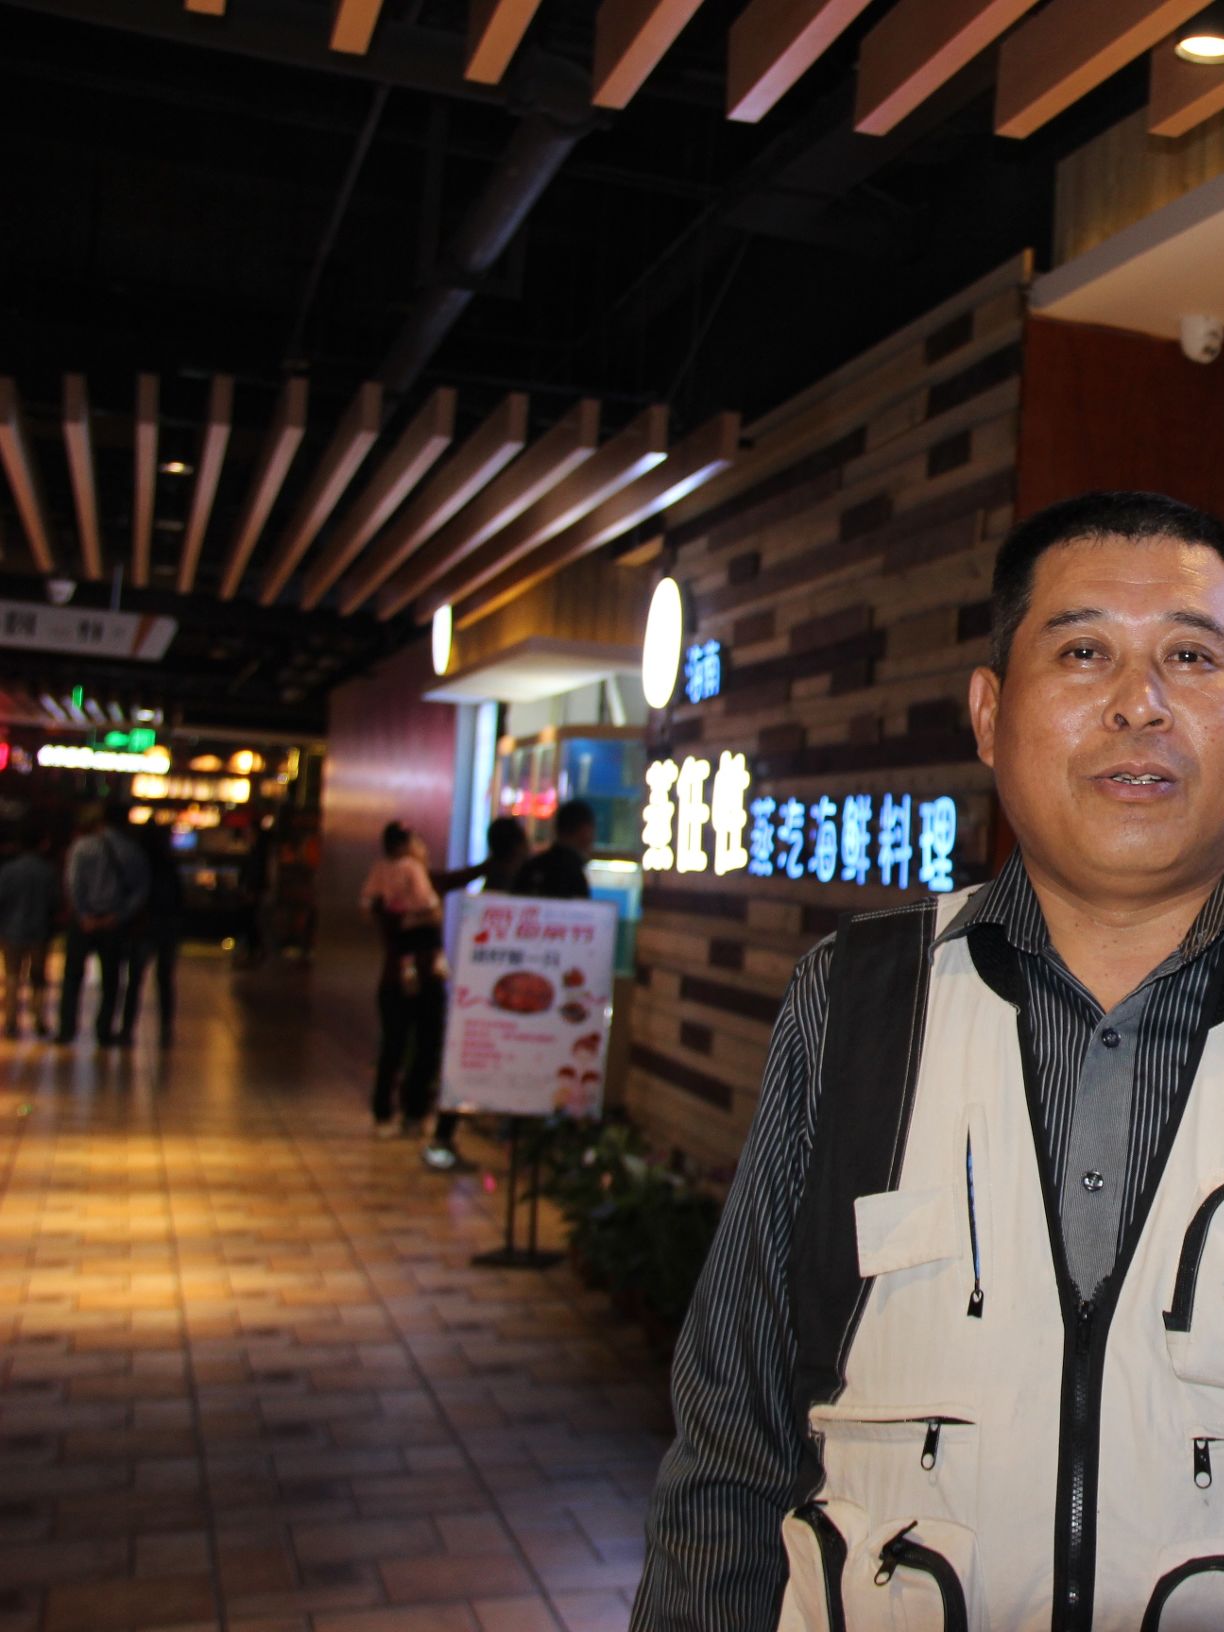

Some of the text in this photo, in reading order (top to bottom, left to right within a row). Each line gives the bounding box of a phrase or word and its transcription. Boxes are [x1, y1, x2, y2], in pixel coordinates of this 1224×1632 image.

[748, 792, 957, 892] 蒸汽海鲜料理
